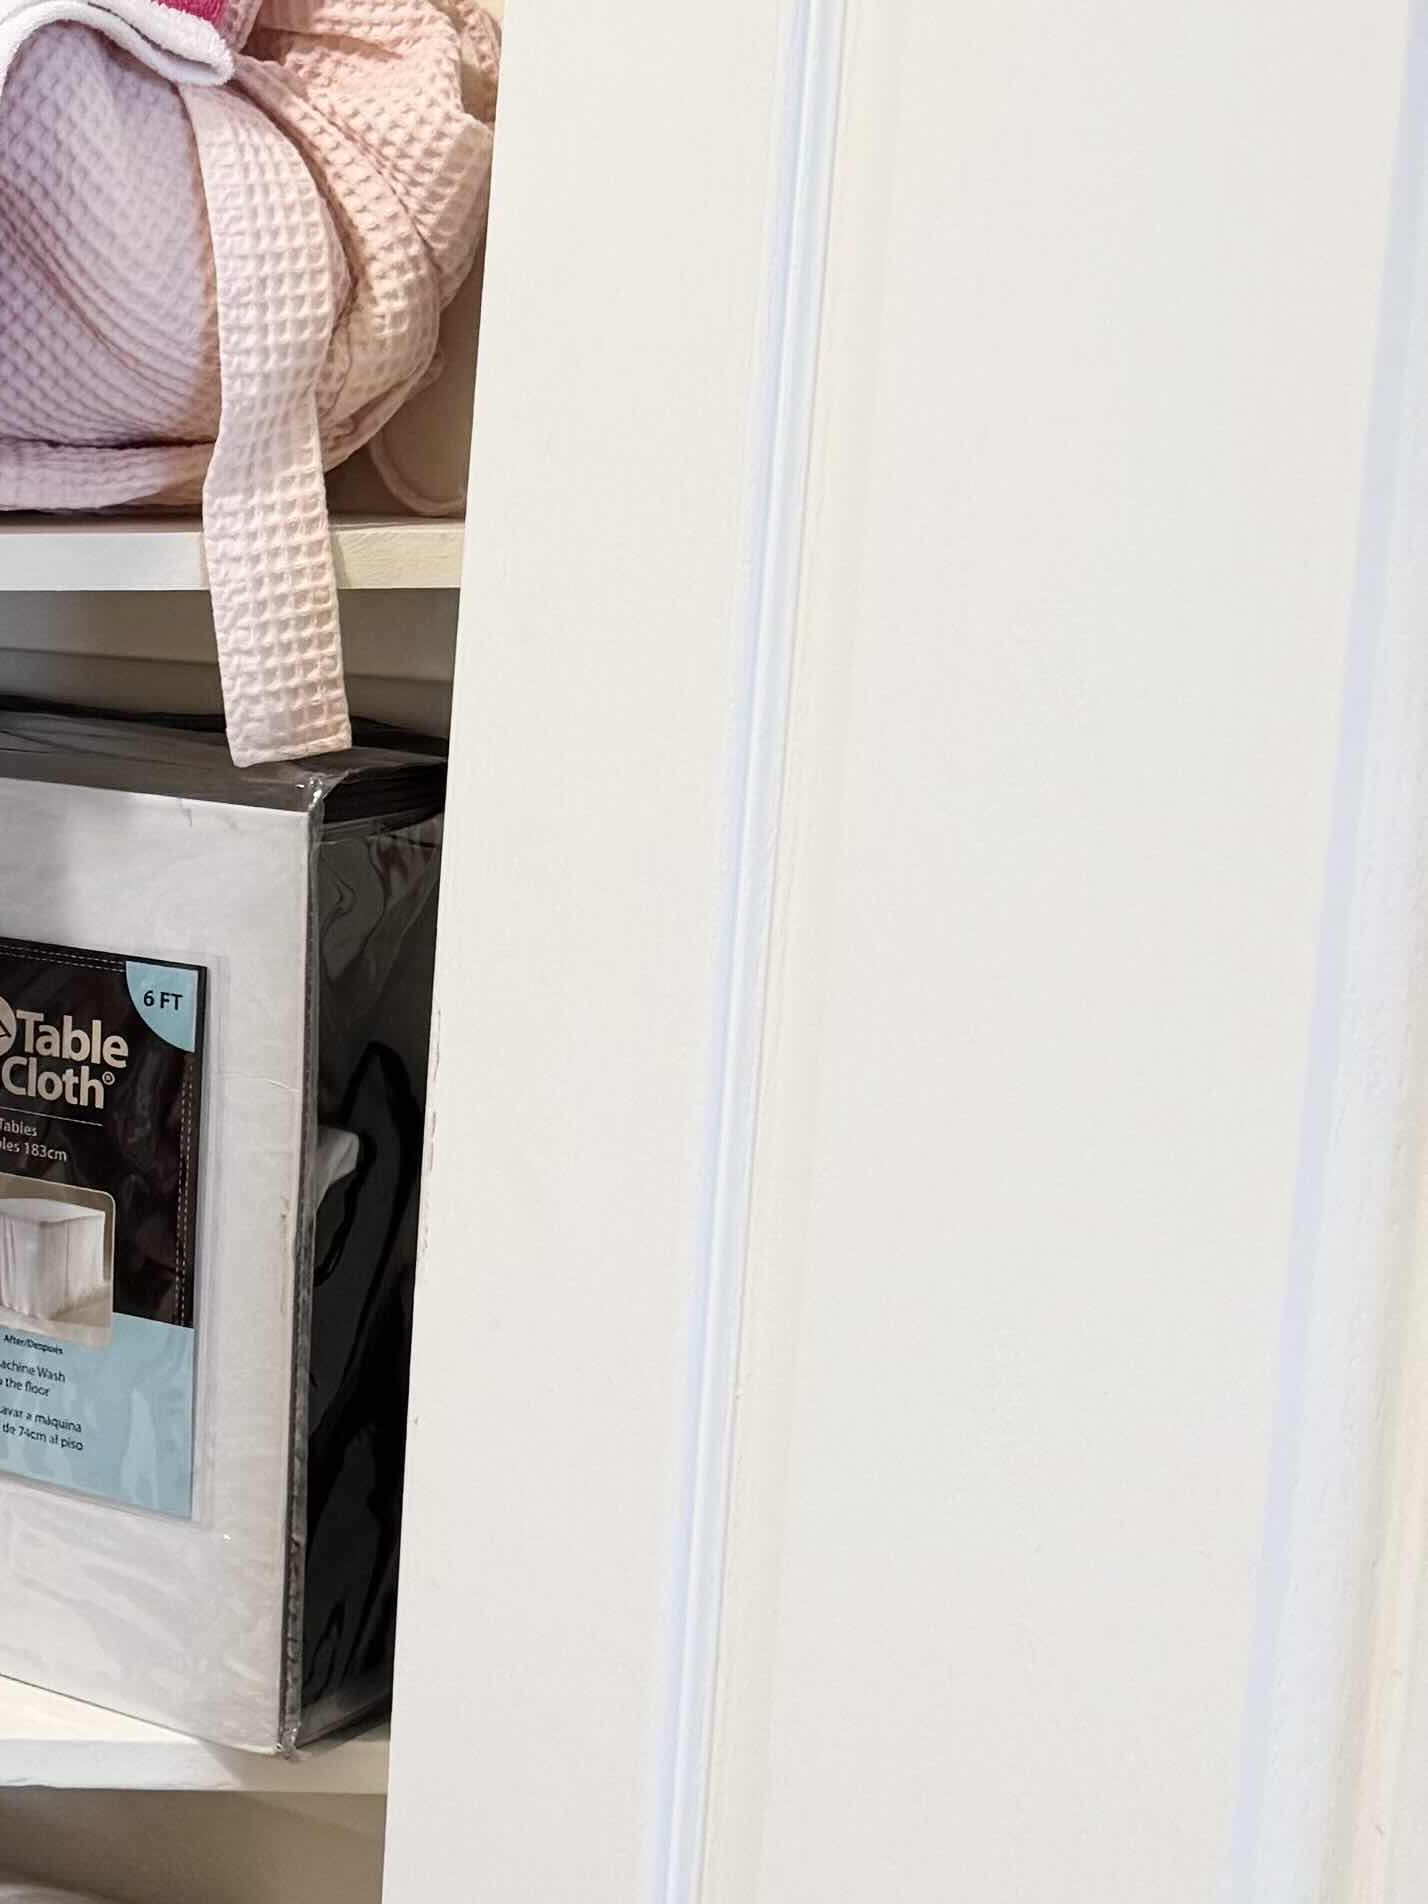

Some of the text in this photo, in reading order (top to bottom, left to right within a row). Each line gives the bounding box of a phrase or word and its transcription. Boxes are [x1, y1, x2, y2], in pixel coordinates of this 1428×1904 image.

[143, 990, 184, 1011] 6 FT
[15, 1009, 129, 1070] Table
[23, 1142, 68, 1162] 183cm
[5, 1377, 23, 1391] the
[36, 1365, 66, 1384] Wash
[60, 1437, 85, 1452] piso
